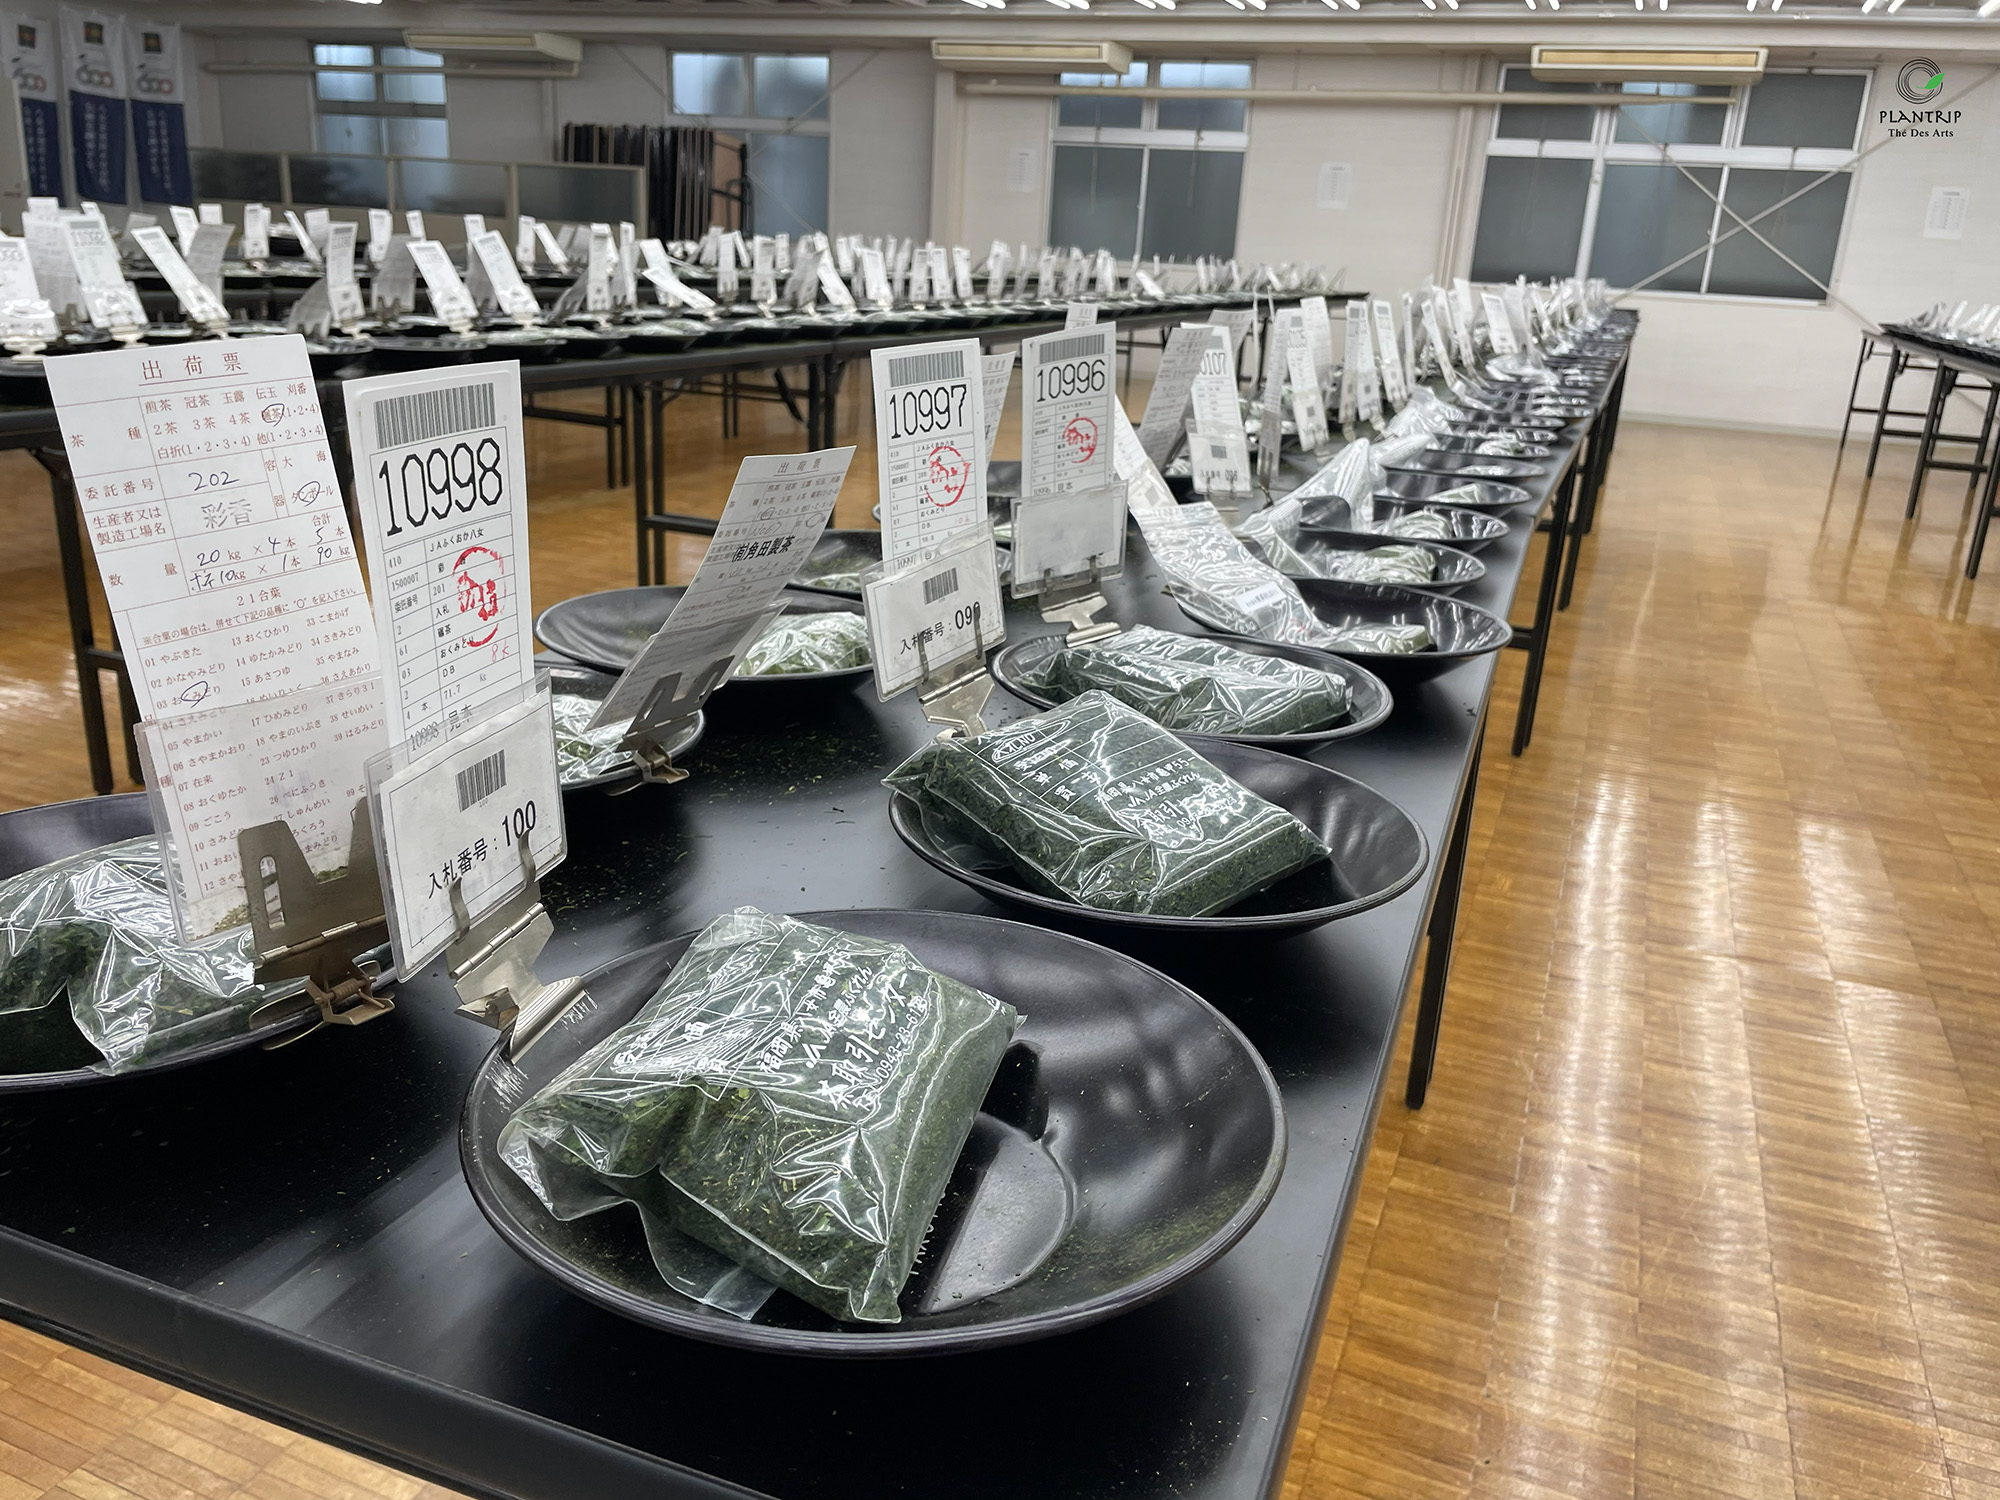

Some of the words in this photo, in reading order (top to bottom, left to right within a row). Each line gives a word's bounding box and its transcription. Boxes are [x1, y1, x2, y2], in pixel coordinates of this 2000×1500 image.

[142, 352, 242, 381] 出荷票
[1037, 359, 1105, 402] 10996
[890, 384, 967, 439] 10997
[85, 478, 154, 500] 委託番号
[188, 471, 240, 491] 202
[379, 437, 502, 537] 10998
[93, 506, 162, 529] 生産者又は
[312, 513, 330, 526] 合計
[97, 522, 166, 546] 製造工場名
[197, 549, 220, 566] 20
[228, 550, 241, 561] kg
[318, 546, 332, 566] 90
[306, 618, 316, 627] 33
[319, 607, 349, 623] こまかげ
[232, 637, 242, 646] 13
[245, 624, 290, 643] おくひかり
[311, 637, 321, 646] 34
[323, 625, 362, 643] さきみどり
[145, 658, 155, 667] 01
[160, 647, 202, 663] やぶきた
[236, 657, 246, 667] 14
[249, 642, 302, 663] ゆたかみどり
[315, 657, 325, 666] 35
[328, 647, 360, 663] やまなみ
[151, 679, 161, 688] 02
[166, 662, 225, 685] かなやみどり
[241, 677, 251, 687] 15
[255, 666, 291, 684] あさつゆ
[157, 700, 168, 709] 03
[325, 695, 334, 704] 37
[251, 717, 260, 727] 17
[264, 703, 308, 723] ひめみどり
[342, 704, 373, 719] せいめい
[168, 742, 178, 751] 05
[182, 729, 222, 747] やまかい
[255, 737, 266, 746] 18
[269, 720, 321, 741] やまのいぶき
[334, 733, 343, 741] 39
[346, 720, 384, 738] はるみどり
[173, 762, 183, 772] 06
[188, 743, 245, 768] さやまかおり
[260, 756, 270, 766] 23
[273, 741, 317, 759] つゆひかり
[178, 782, 189, 792] 07
[184, 801, 194, 812] 08
[199, 786, 246, 807] おくゆたか
[189, 822, 199, 832] 09
[194, 842, 205, 852] 10
